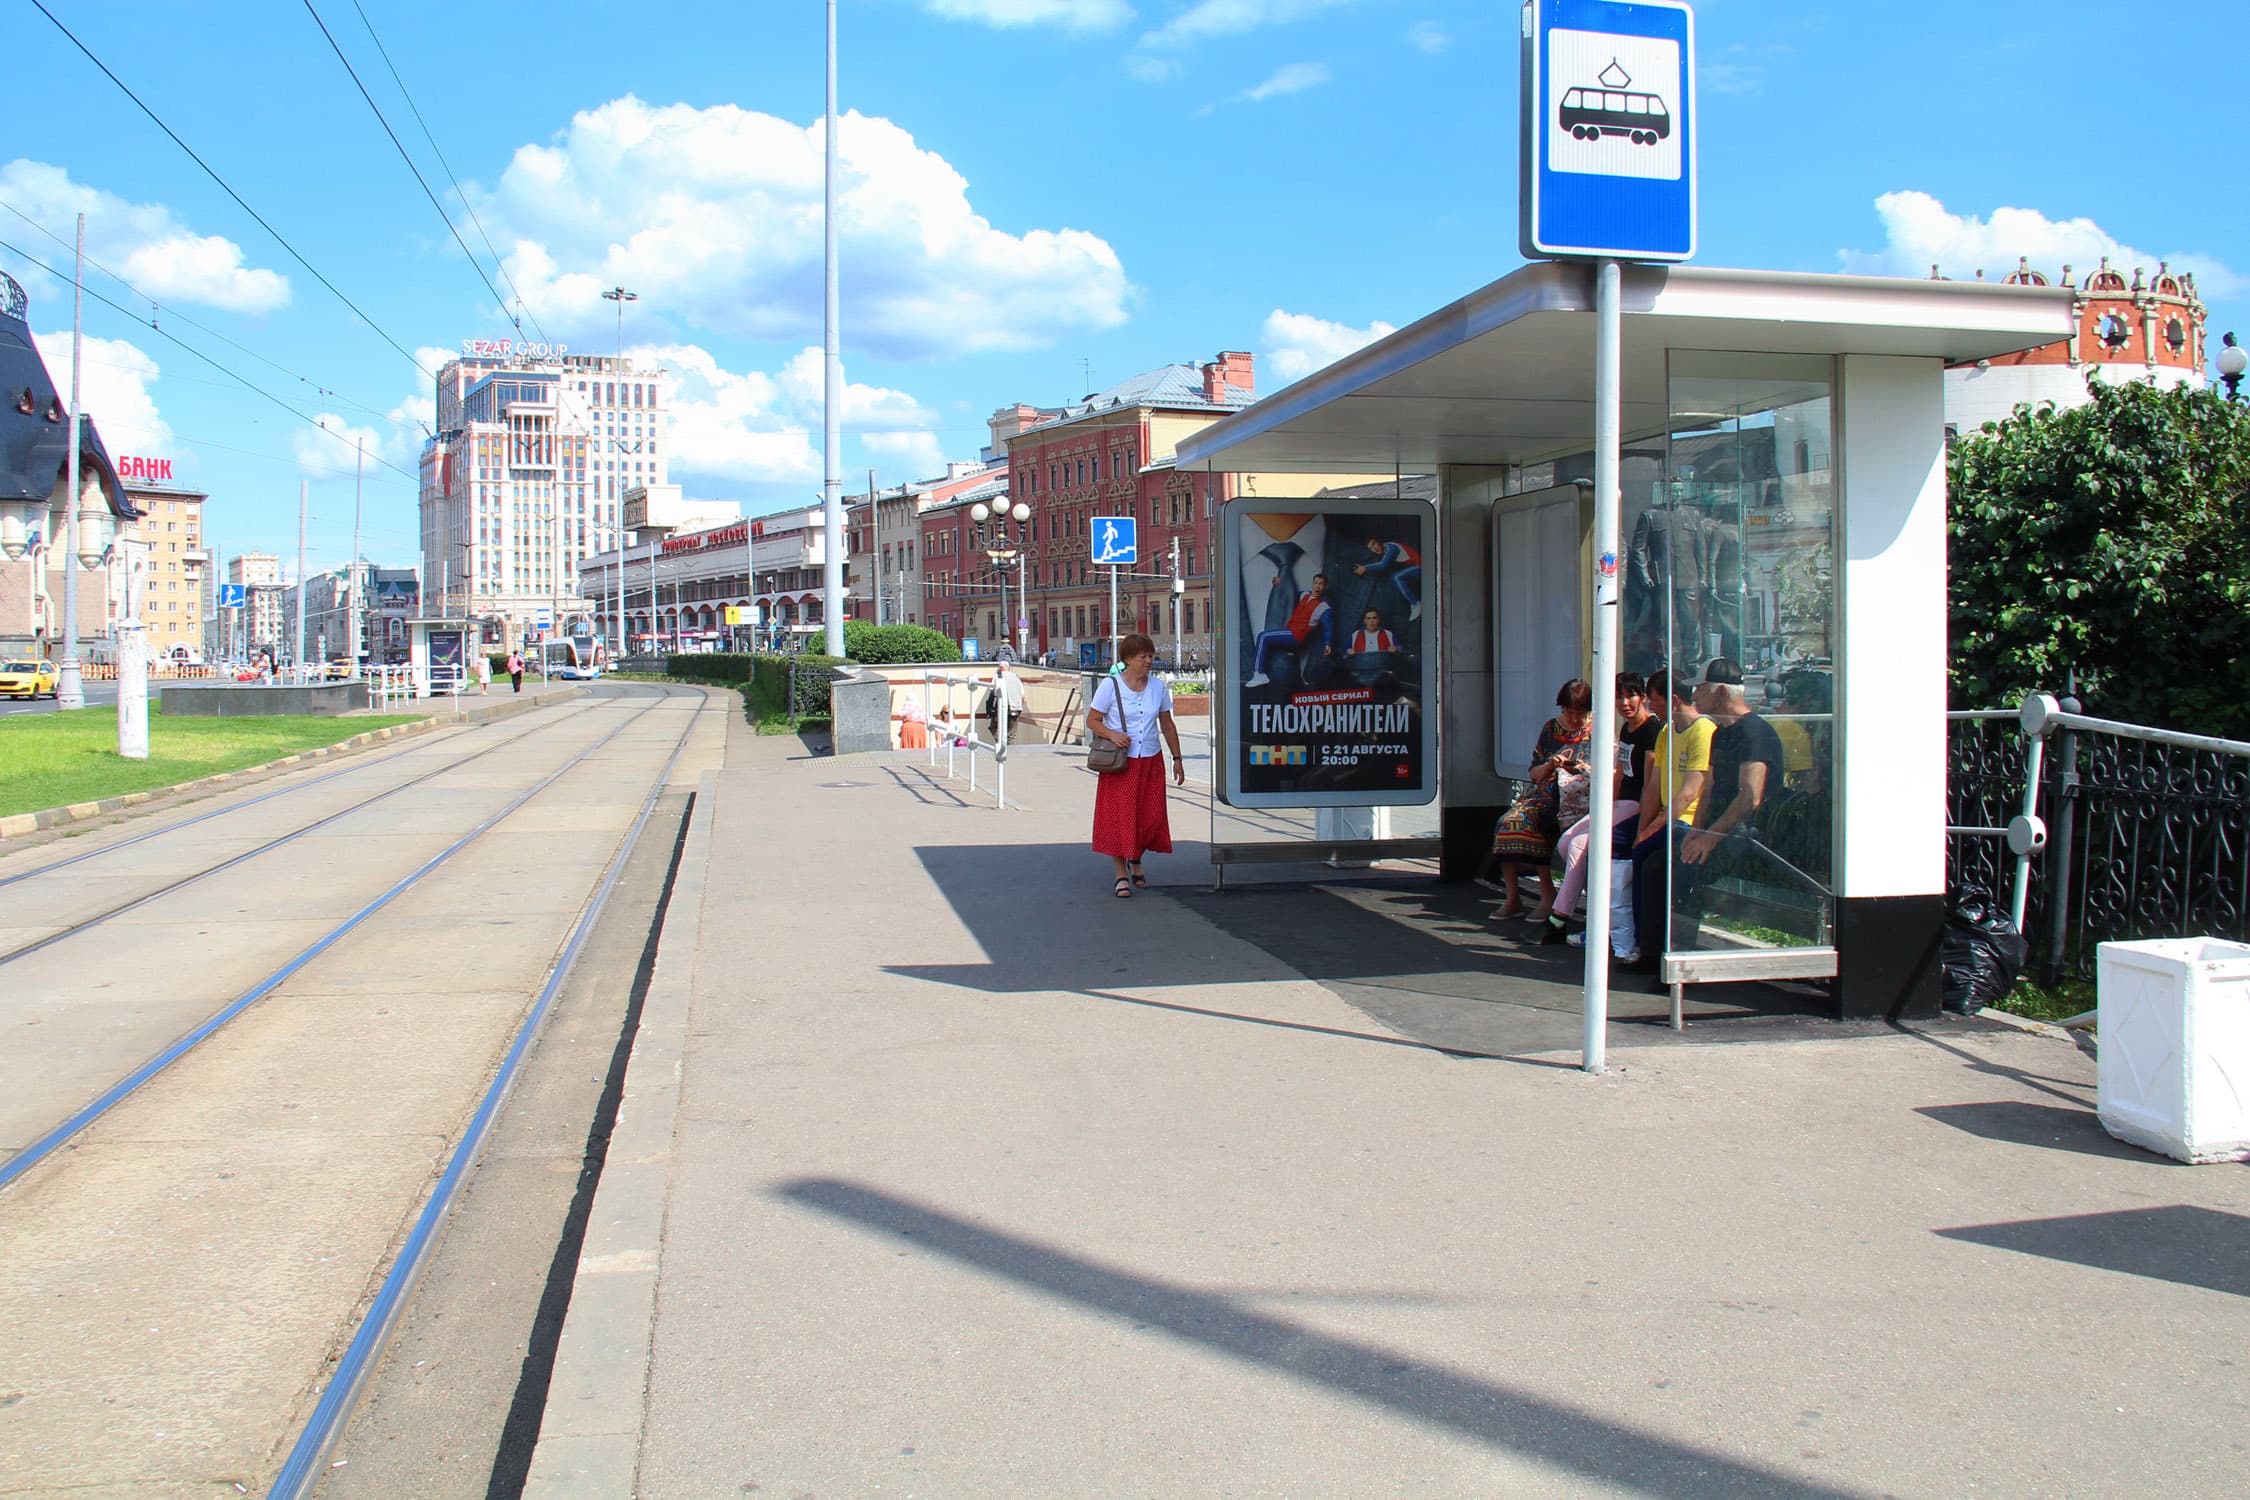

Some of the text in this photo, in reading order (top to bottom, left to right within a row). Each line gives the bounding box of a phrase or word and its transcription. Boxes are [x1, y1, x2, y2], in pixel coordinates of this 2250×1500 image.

[463, 339, 568, 357] SEZAR GROUP
[119, 456, 173, 479] БАНК
[1295, 691, 1370, 703] НОВЫЙ СЕРИАЛ
[1250, 704, 1409, 733] ТЕЛОХРАНИТЕЛИ
[1250, 745, 1307, 766] ТНТ
[1321, 745, 1409, 755] С 21 АВГУСТА
[1321, 755, 1358, 765] 20:00
